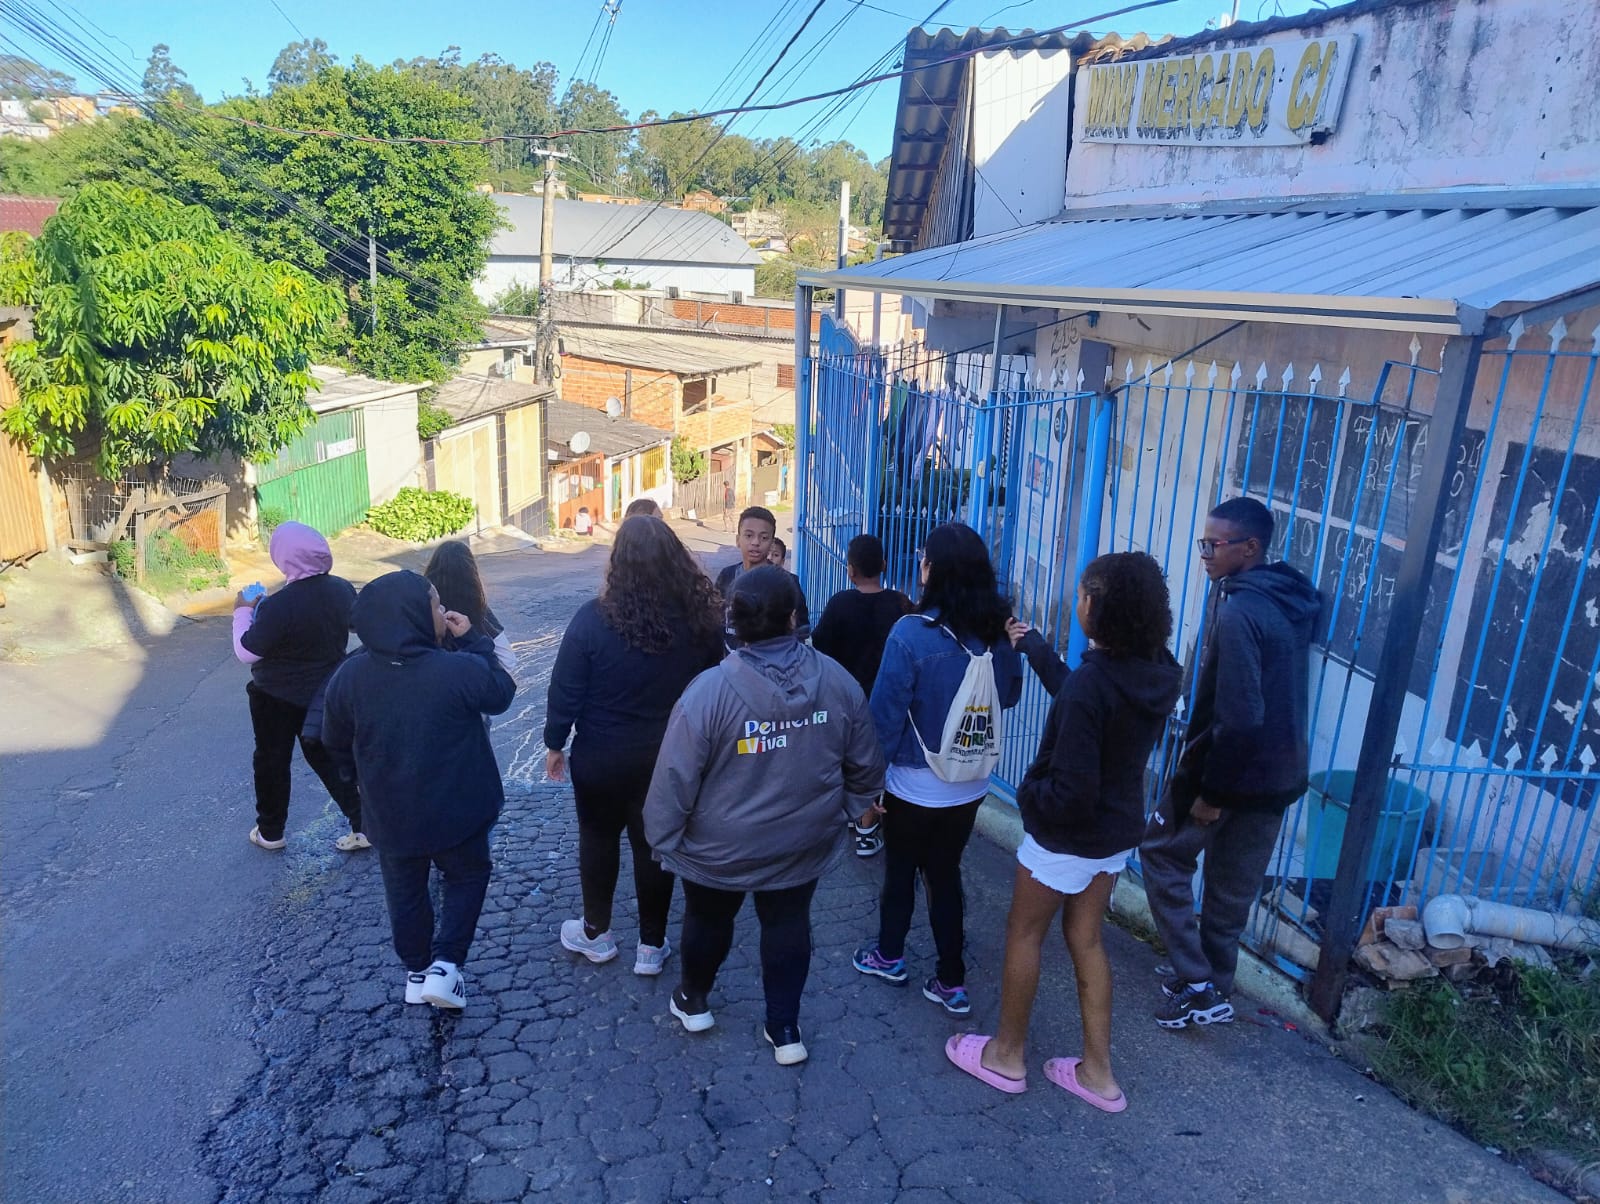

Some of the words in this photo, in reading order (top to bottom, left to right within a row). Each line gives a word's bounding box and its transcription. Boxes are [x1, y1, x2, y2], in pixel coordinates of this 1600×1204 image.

[1085, 64, 1138, 129] MINI
[1136, 47, 1274, 129] MERCADO
[1354, 415, 1429, 456] FANTA
[746, 734, 787, 754] Viva
